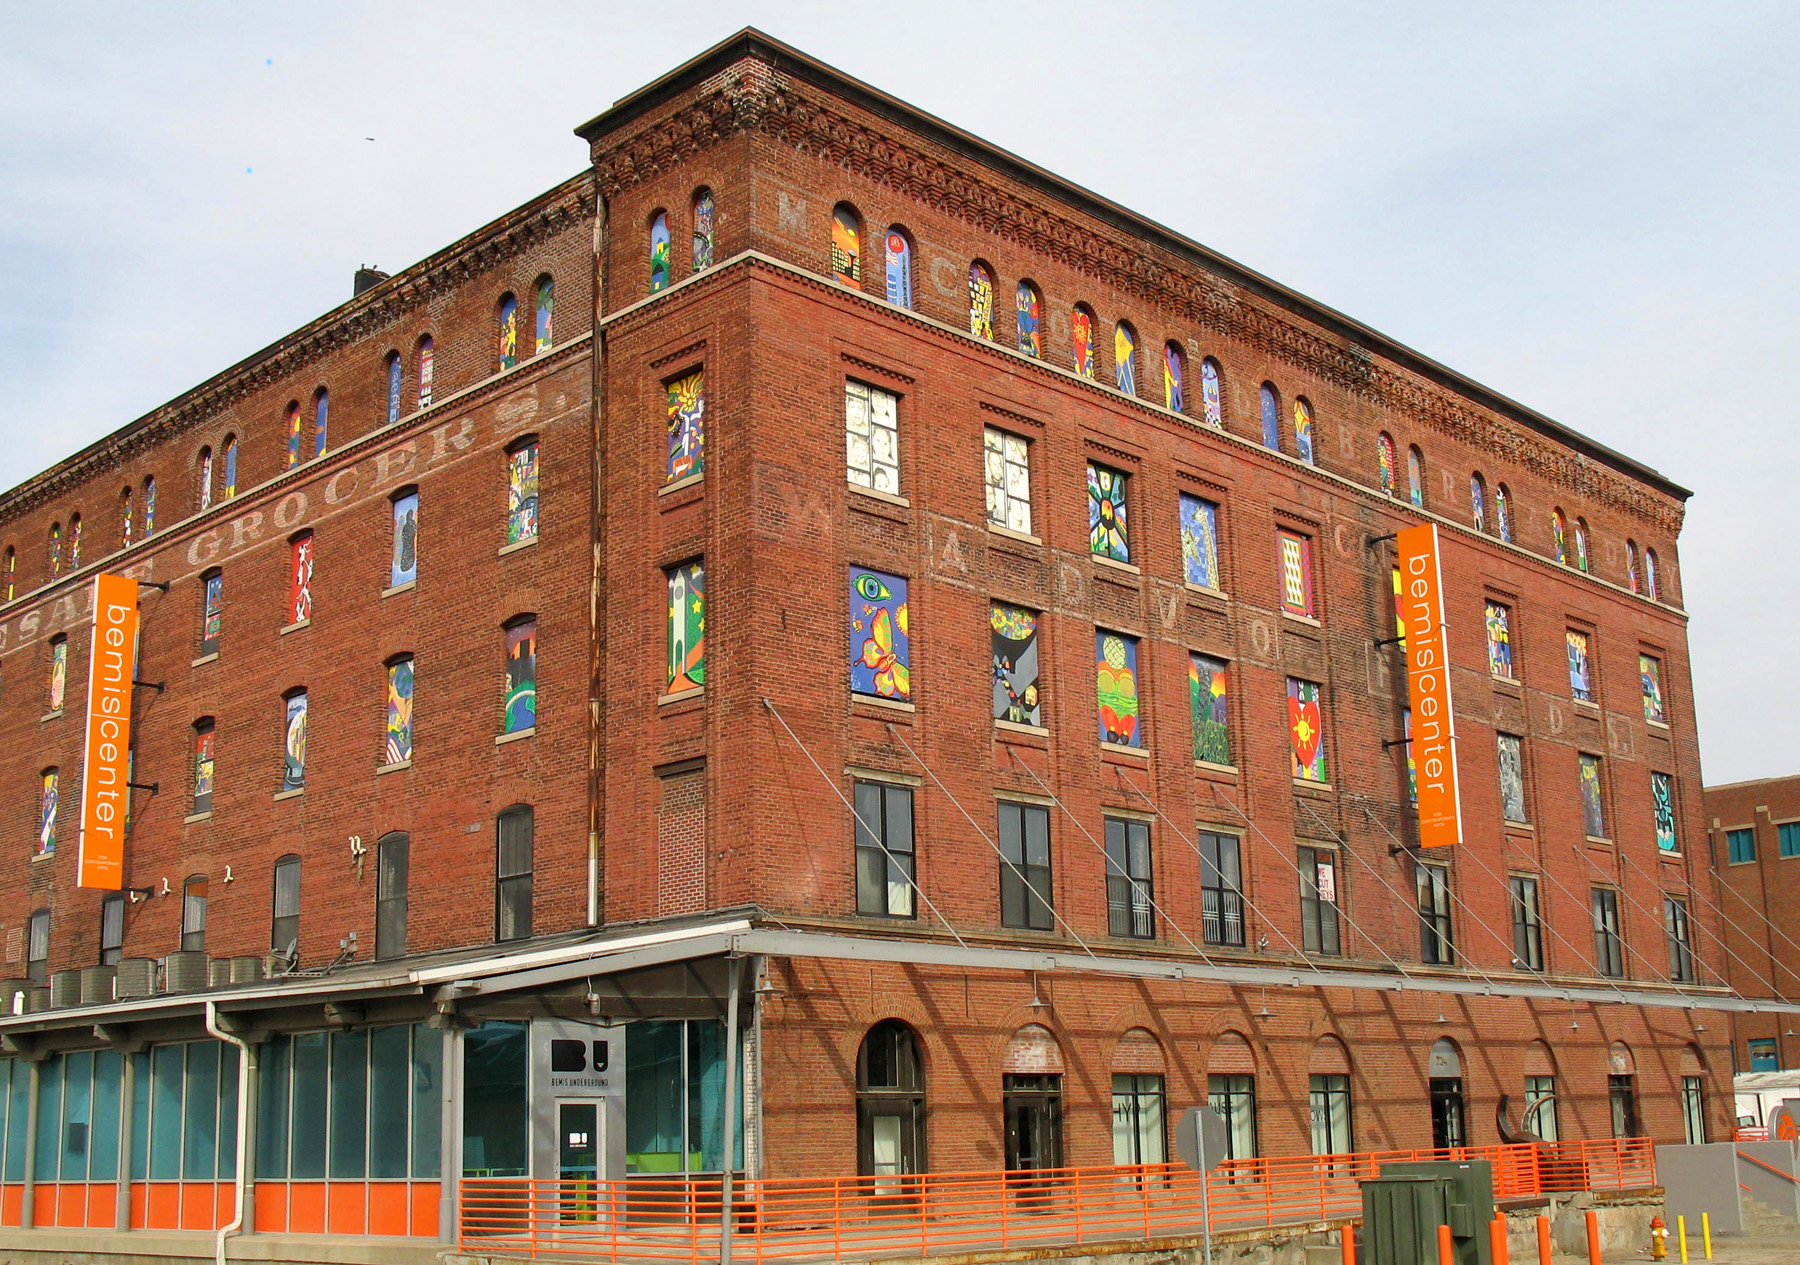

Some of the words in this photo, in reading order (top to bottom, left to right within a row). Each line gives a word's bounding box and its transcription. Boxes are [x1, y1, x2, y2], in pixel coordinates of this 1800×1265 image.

[102, 604, 131, 713] bemis
[1409, 553, 1438, 667] bemis
[95, 720, 120, 839] center
[1418, 674, 1446, 794] center
[551, 1039, 608, 1072] BU
[551, 1078, 568, 1087] BEMIS
[569, 1078, 609, 1087] UNDERGROUND
